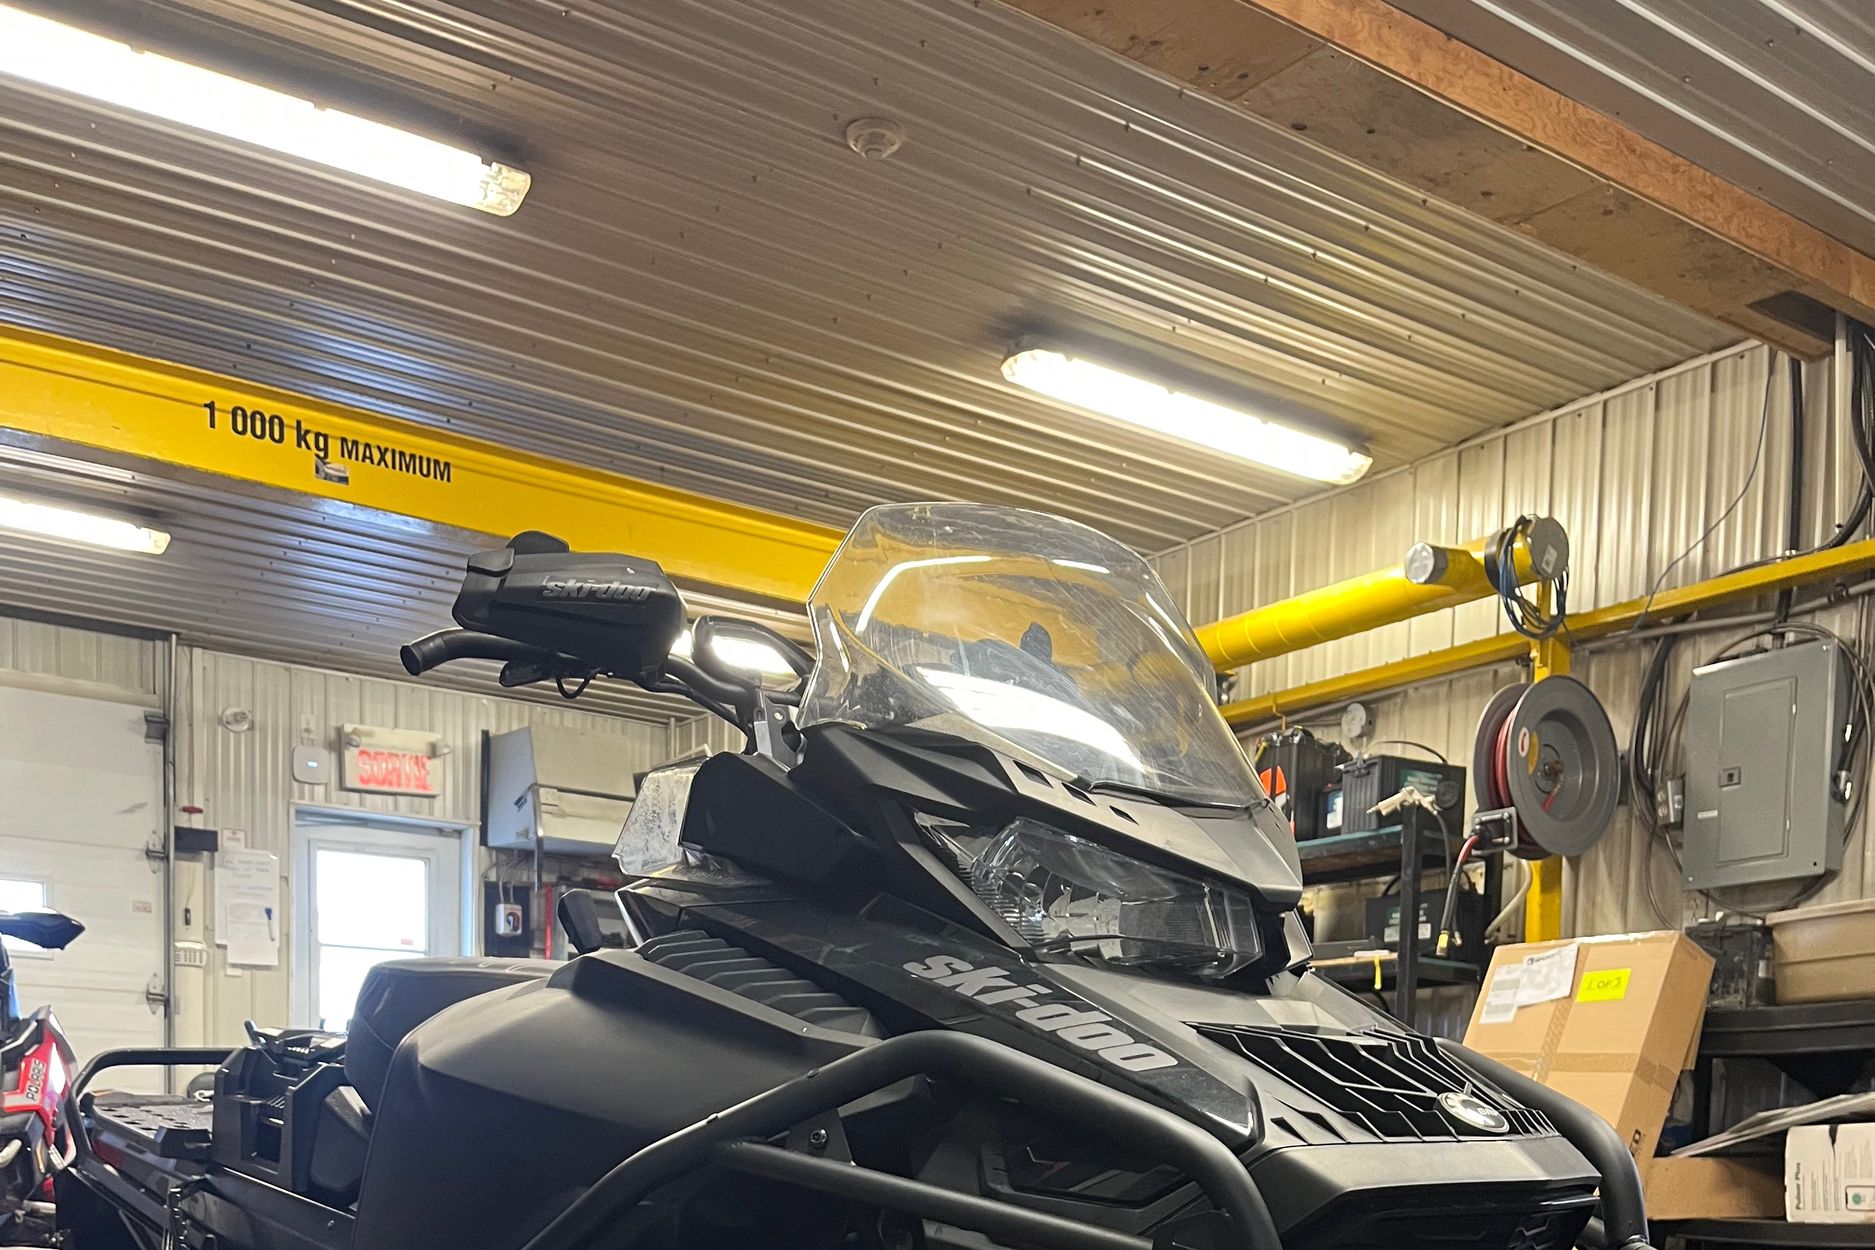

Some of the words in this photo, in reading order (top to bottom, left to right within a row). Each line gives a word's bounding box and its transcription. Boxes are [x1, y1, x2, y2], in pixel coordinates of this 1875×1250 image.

[203, 401, 216, 429] 1
[231, 406, 285, 444] 000
[296, 420, 329, 460] kg
[340, 436, 452, 483] MAXIMUM
